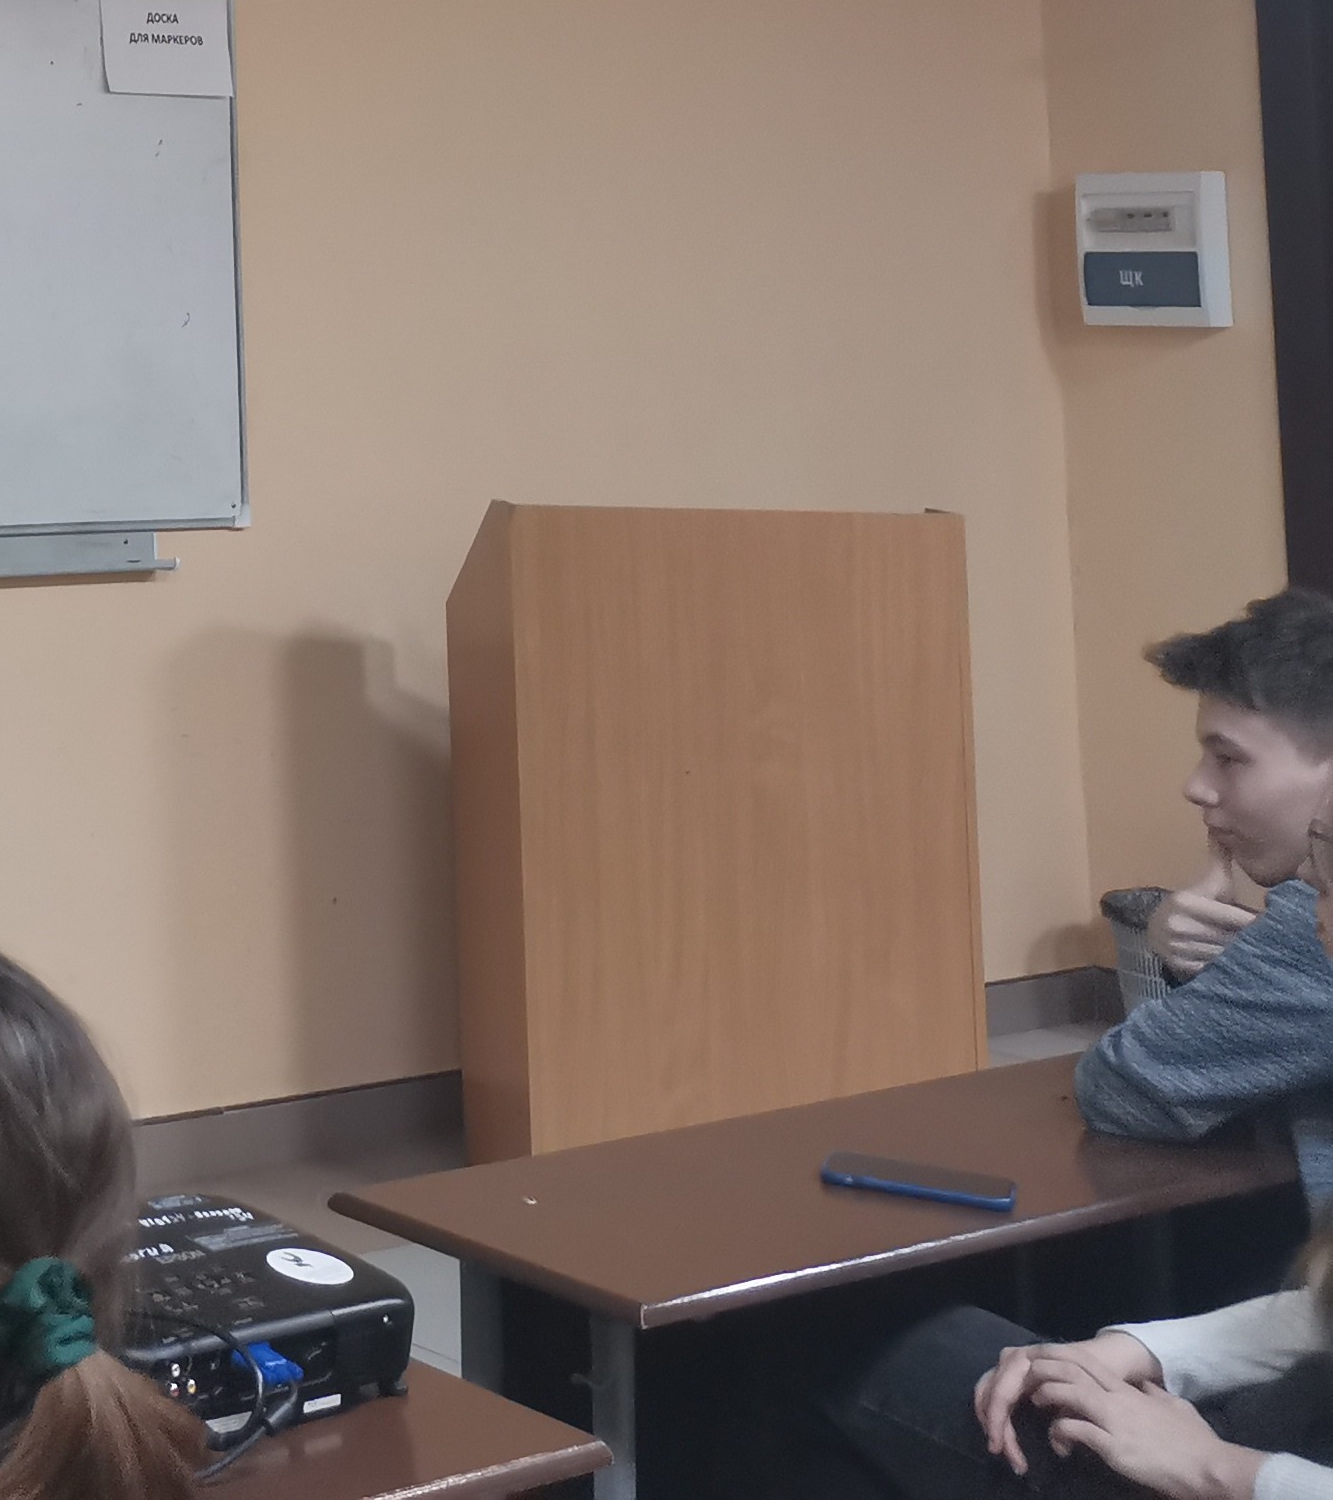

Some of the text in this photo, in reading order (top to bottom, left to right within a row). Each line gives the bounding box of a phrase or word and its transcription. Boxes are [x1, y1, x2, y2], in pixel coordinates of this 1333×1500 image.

[146, 12, 179, 25] ДОСКА
[129, 32, 204, 46] ДЛЯ МАРКЕРОВ
